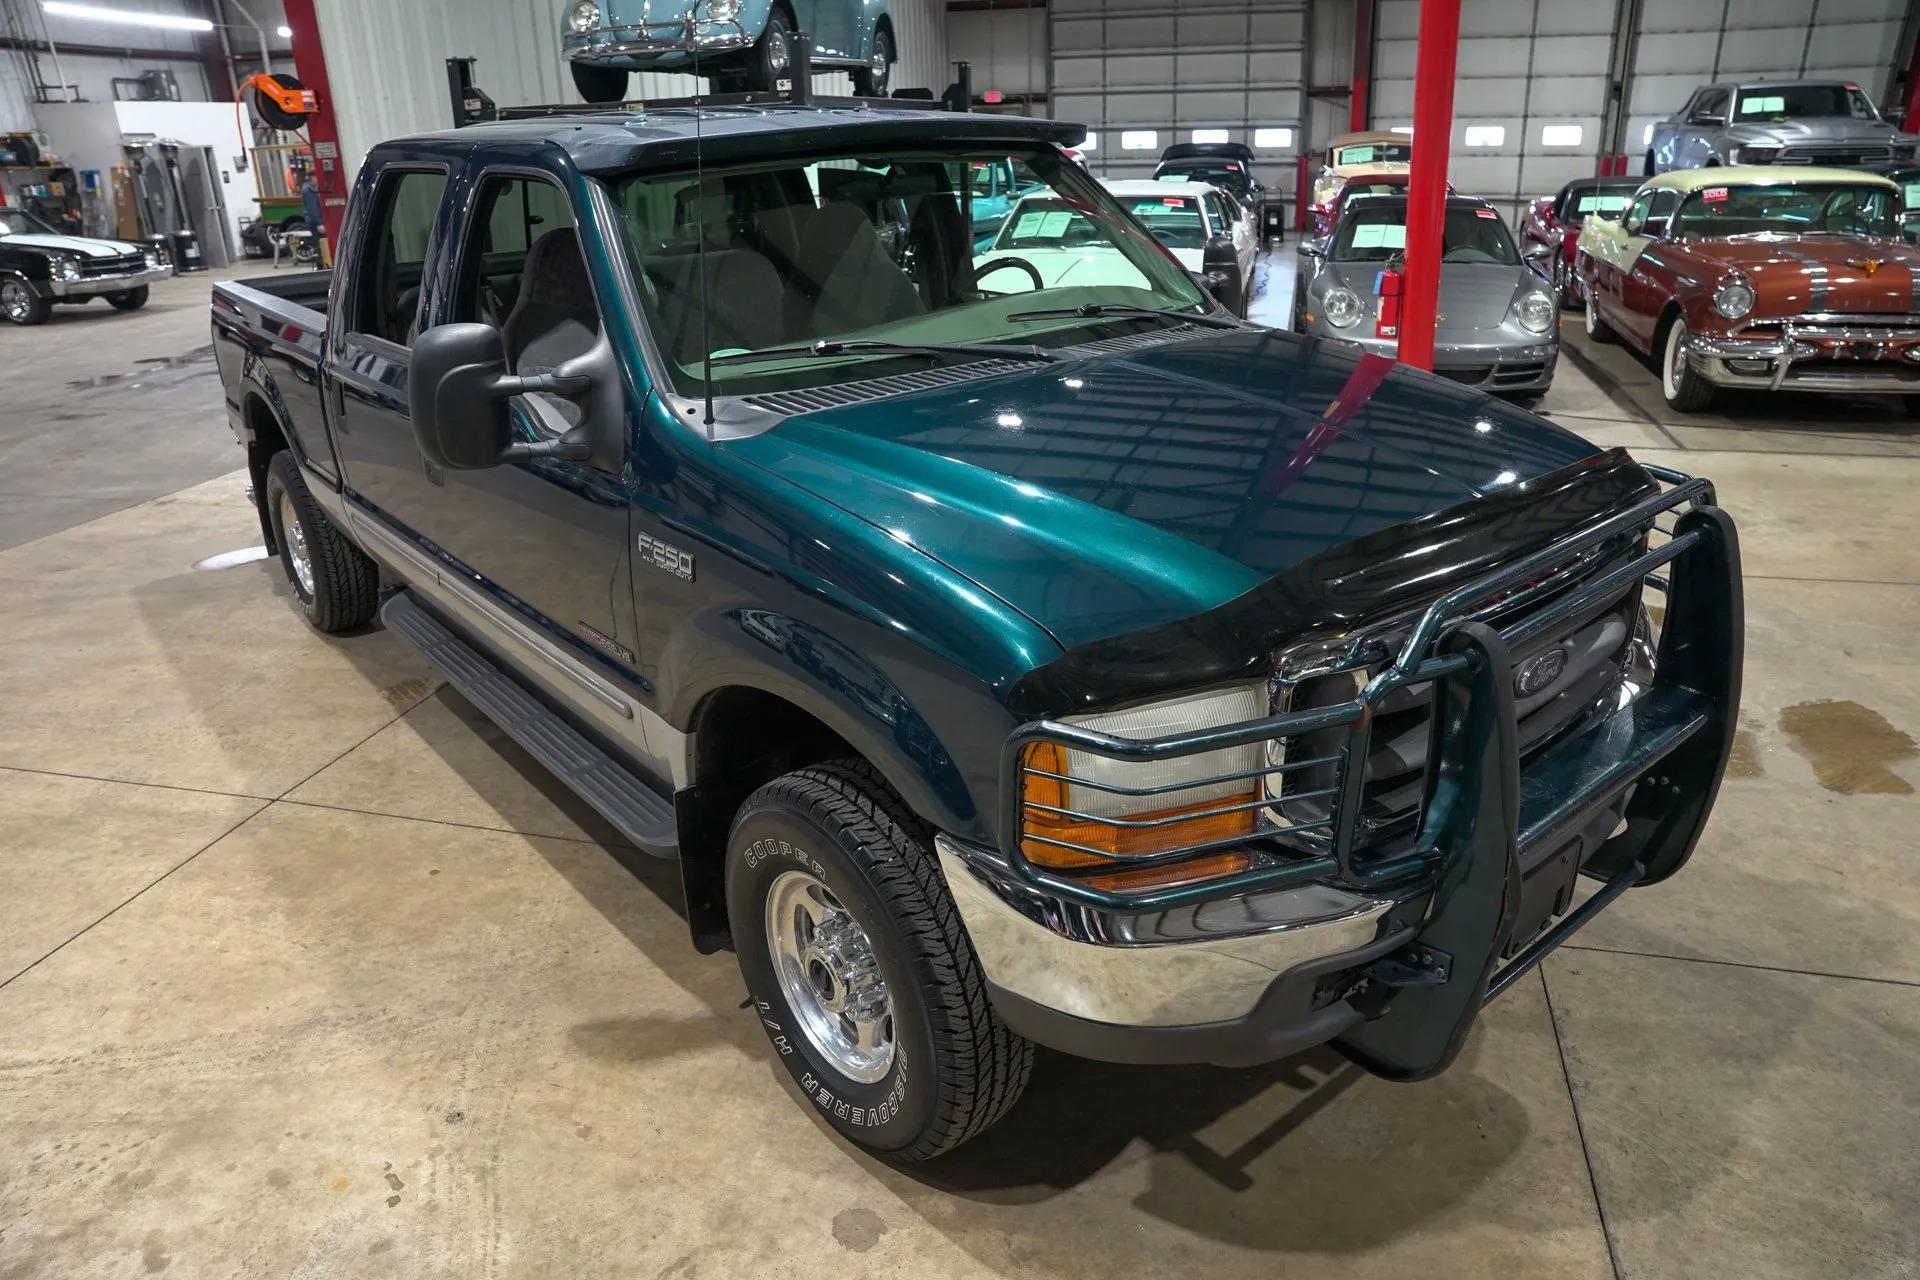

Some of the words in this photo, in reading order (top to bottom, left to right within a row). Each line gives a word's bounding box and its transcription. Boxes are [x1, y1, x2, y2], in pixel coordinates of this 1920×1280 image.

[1703, 190, 1728, 199] SOLD
[675, 569, 693, 581] DUTY
[1533, 658, 1561, 686] Ford
[744, 838, 826, 881] COOPER
[754, 996, 793, 1055] H/T
[801, 1040, 908, 1126] DISCOVERER
